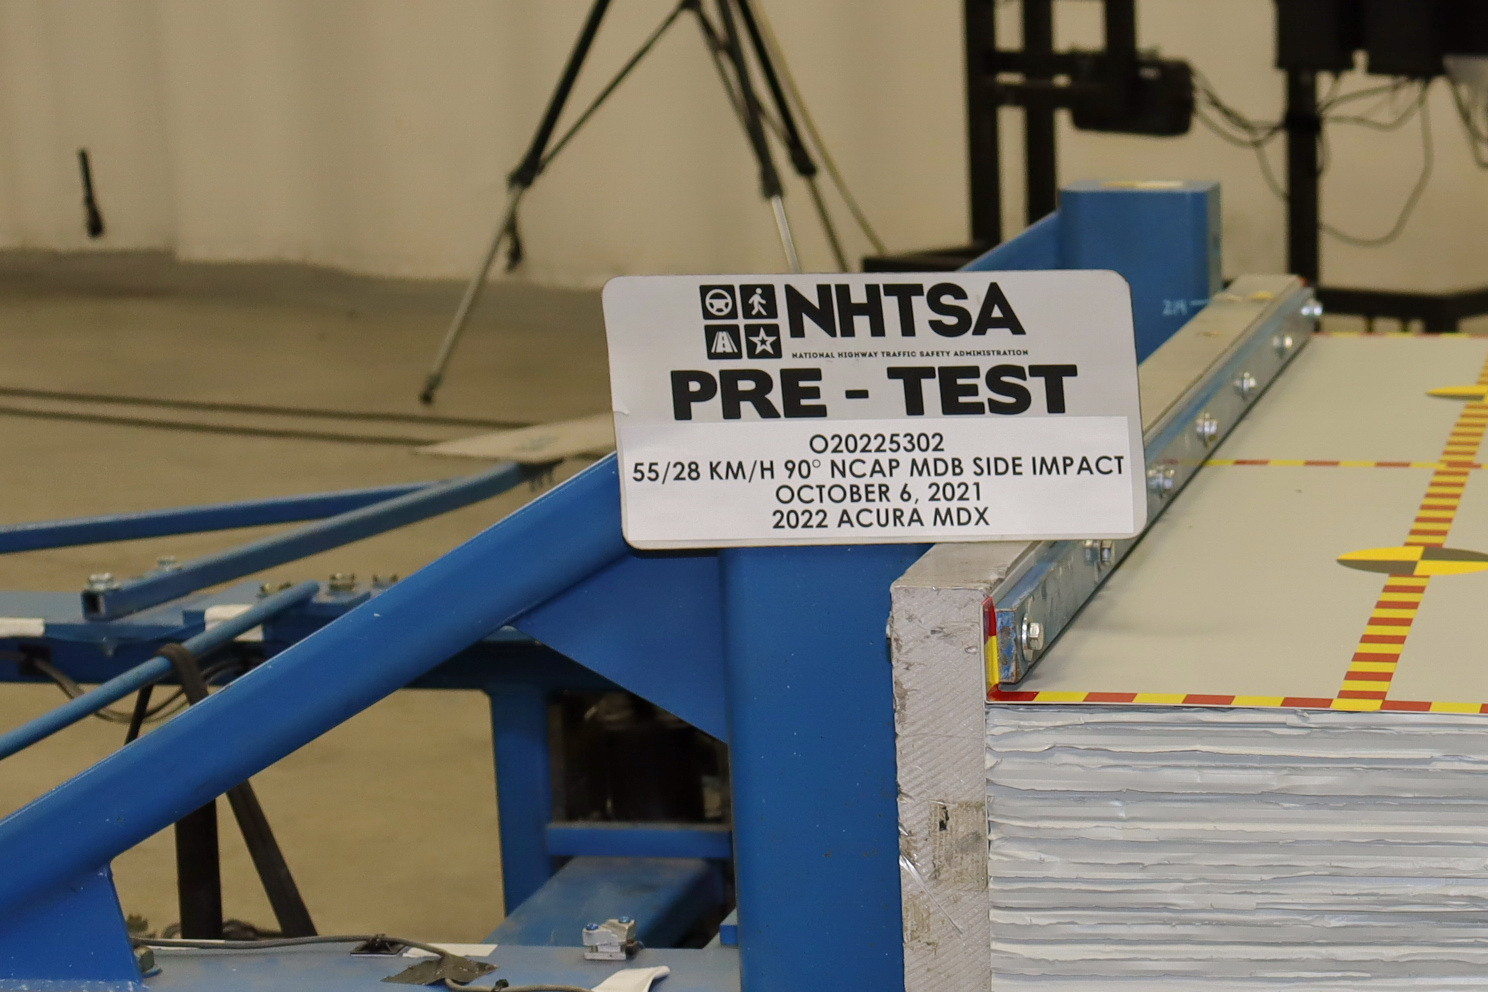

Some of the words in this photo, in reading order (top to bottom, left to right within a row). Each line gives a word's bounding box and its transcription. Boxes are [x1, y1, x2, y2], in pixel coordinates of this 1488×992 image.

[785, 282, 1027, 338] NHTSA
[792, 351, 835, 359] NATIONAL
[838, 351, 878, 359] HIGHWAY
[919, 350, 950, 358] SAFETY
[953, 349, 1029, 357] ADMINISTRATION
[671, 368, 827, 420] PRE
[887, 364, 1078, 416] TEST
[632, 461, 701, 485] 55/28
[709, 460, 775, 483] KM/H
[830, 458, 900, 479] NCAP
[910, 457, 964, 477] MDB
[972, 456, 1023, 477] SIDE
[1032, 455, 1124, 476] IMPACT
[775, 483, 891, 505] OCTOBER
[899, 483, 920, 506] 6,
[928, 482, 981, 502] 2021
[772, 509, 829, 529] 2022
[837, 507, 925, 528] ACURA
[933, 506, 990, 527] MDX
